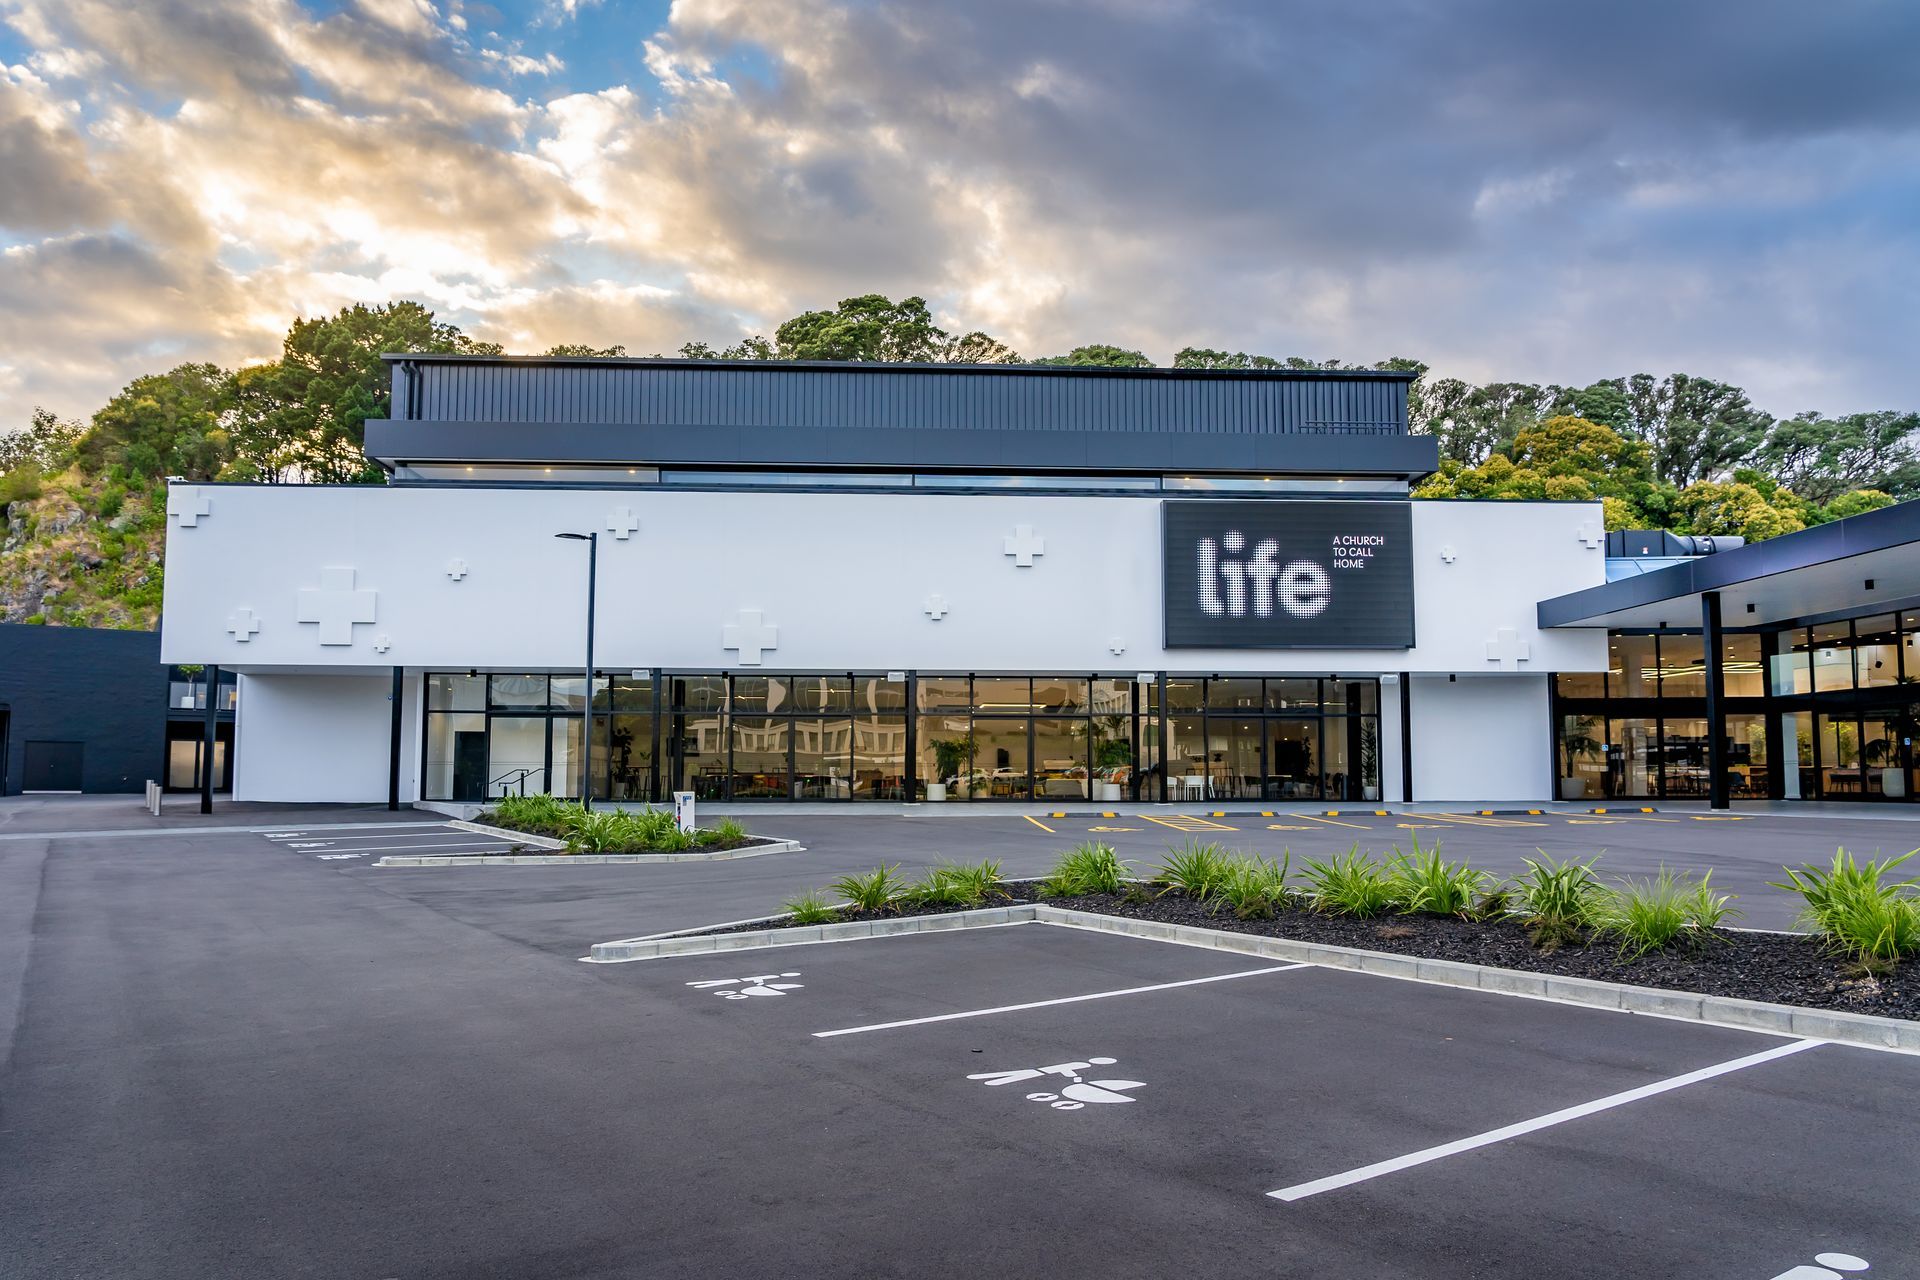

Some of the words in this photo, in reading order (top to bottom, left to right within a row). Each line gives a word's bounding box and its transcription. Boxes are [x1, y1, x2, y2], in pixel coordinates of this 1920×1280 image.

[1333, 535, 1341, 545] A
[1342, 536, 1384, 546] CHURCH
[1333, 547, 1347, 557] TO
[1348, 547, 1374, 557] CALL
[1333, 559, 1364, 569] HOME
[1197, 530, 1331, 618] life
